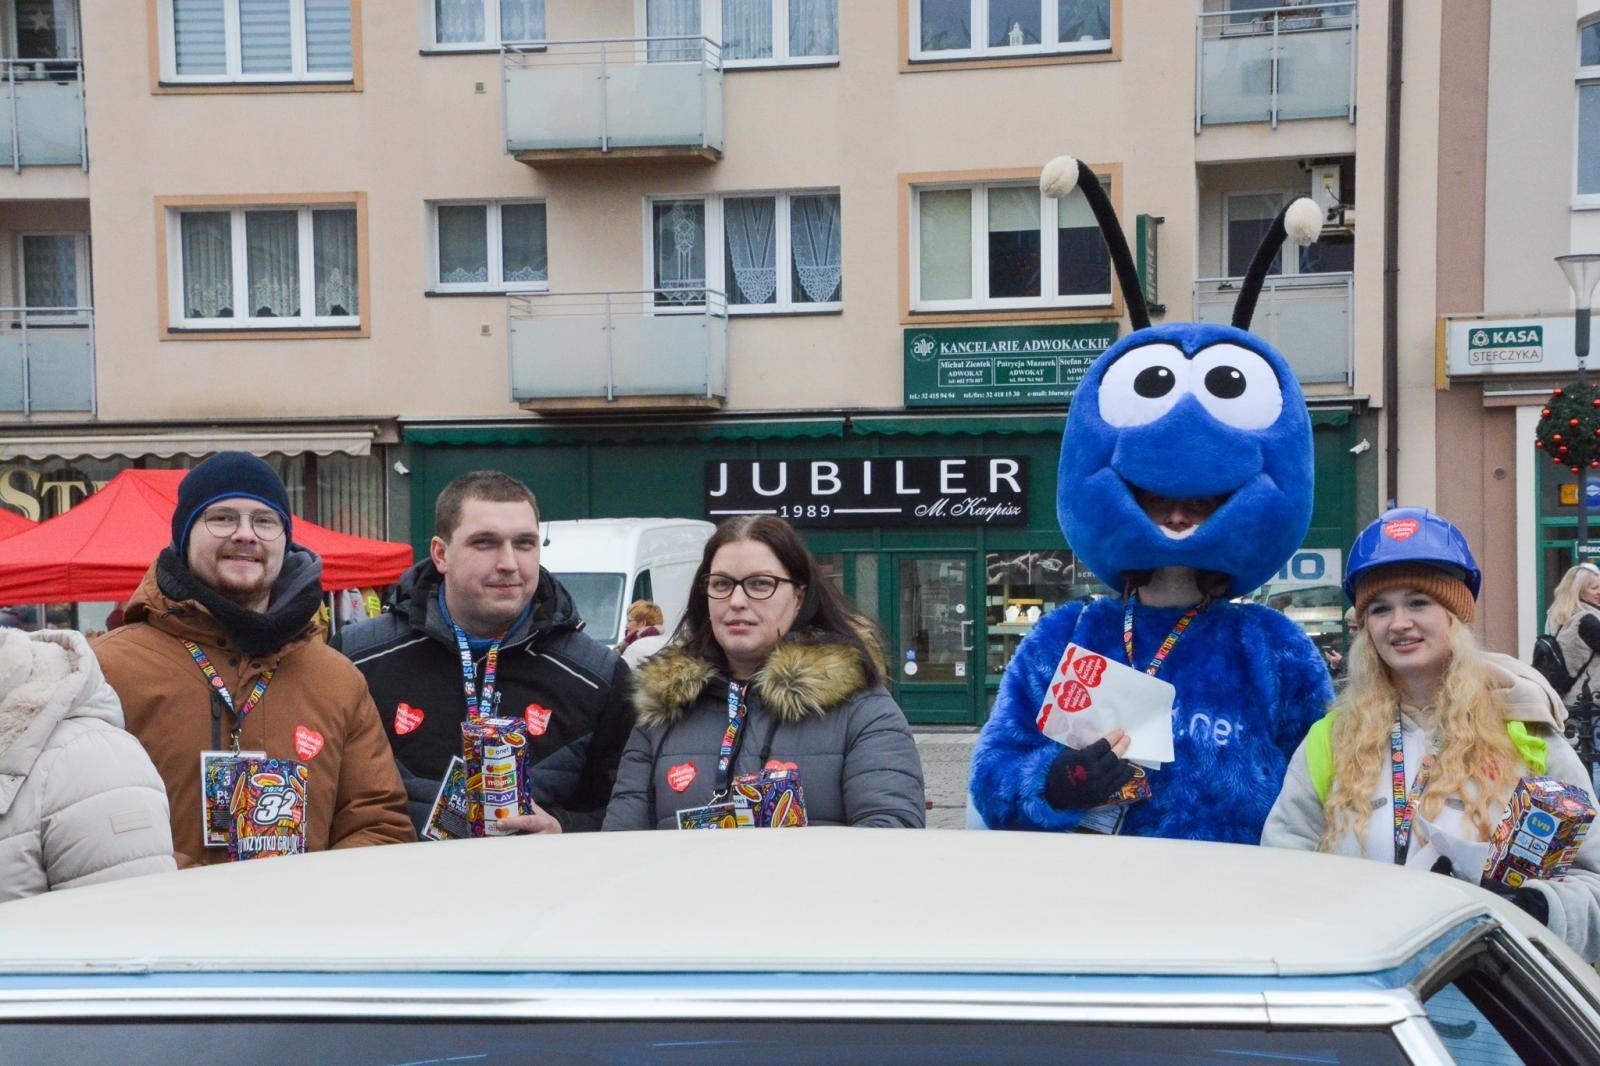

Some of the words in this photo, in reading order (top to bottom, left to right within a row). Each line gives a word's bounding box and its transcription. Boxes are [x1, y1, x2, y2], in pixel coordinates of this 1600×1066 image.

[1492, 330, 1539, 344] KASA
[941, 341, 1020, 353] KANCELARIE
[1022, 338, 1110, 351] ADWOKACKIE
[1059, 358, 1082, 366] Stefan
[1472, 350, 1540, 362] STEFCZYKA
[965, 360, 991, 368] Zientek
[997, 360, 1024, 369] Patrycja
[709, 458, 1022, 497] JUBILER
[0, 467, 110, 522] ST
[780, 505, 831, 518] 1989
[914, 499, 947, 517] M.
[951, 497, 1022, 523] Karpisz
[487, 792, 513, 801] PLAY
[254, 788, 297, 824] 32
[1532, 816, 1551, 832] tvn
[243, 835, 277, 852] WSZYSTKO
